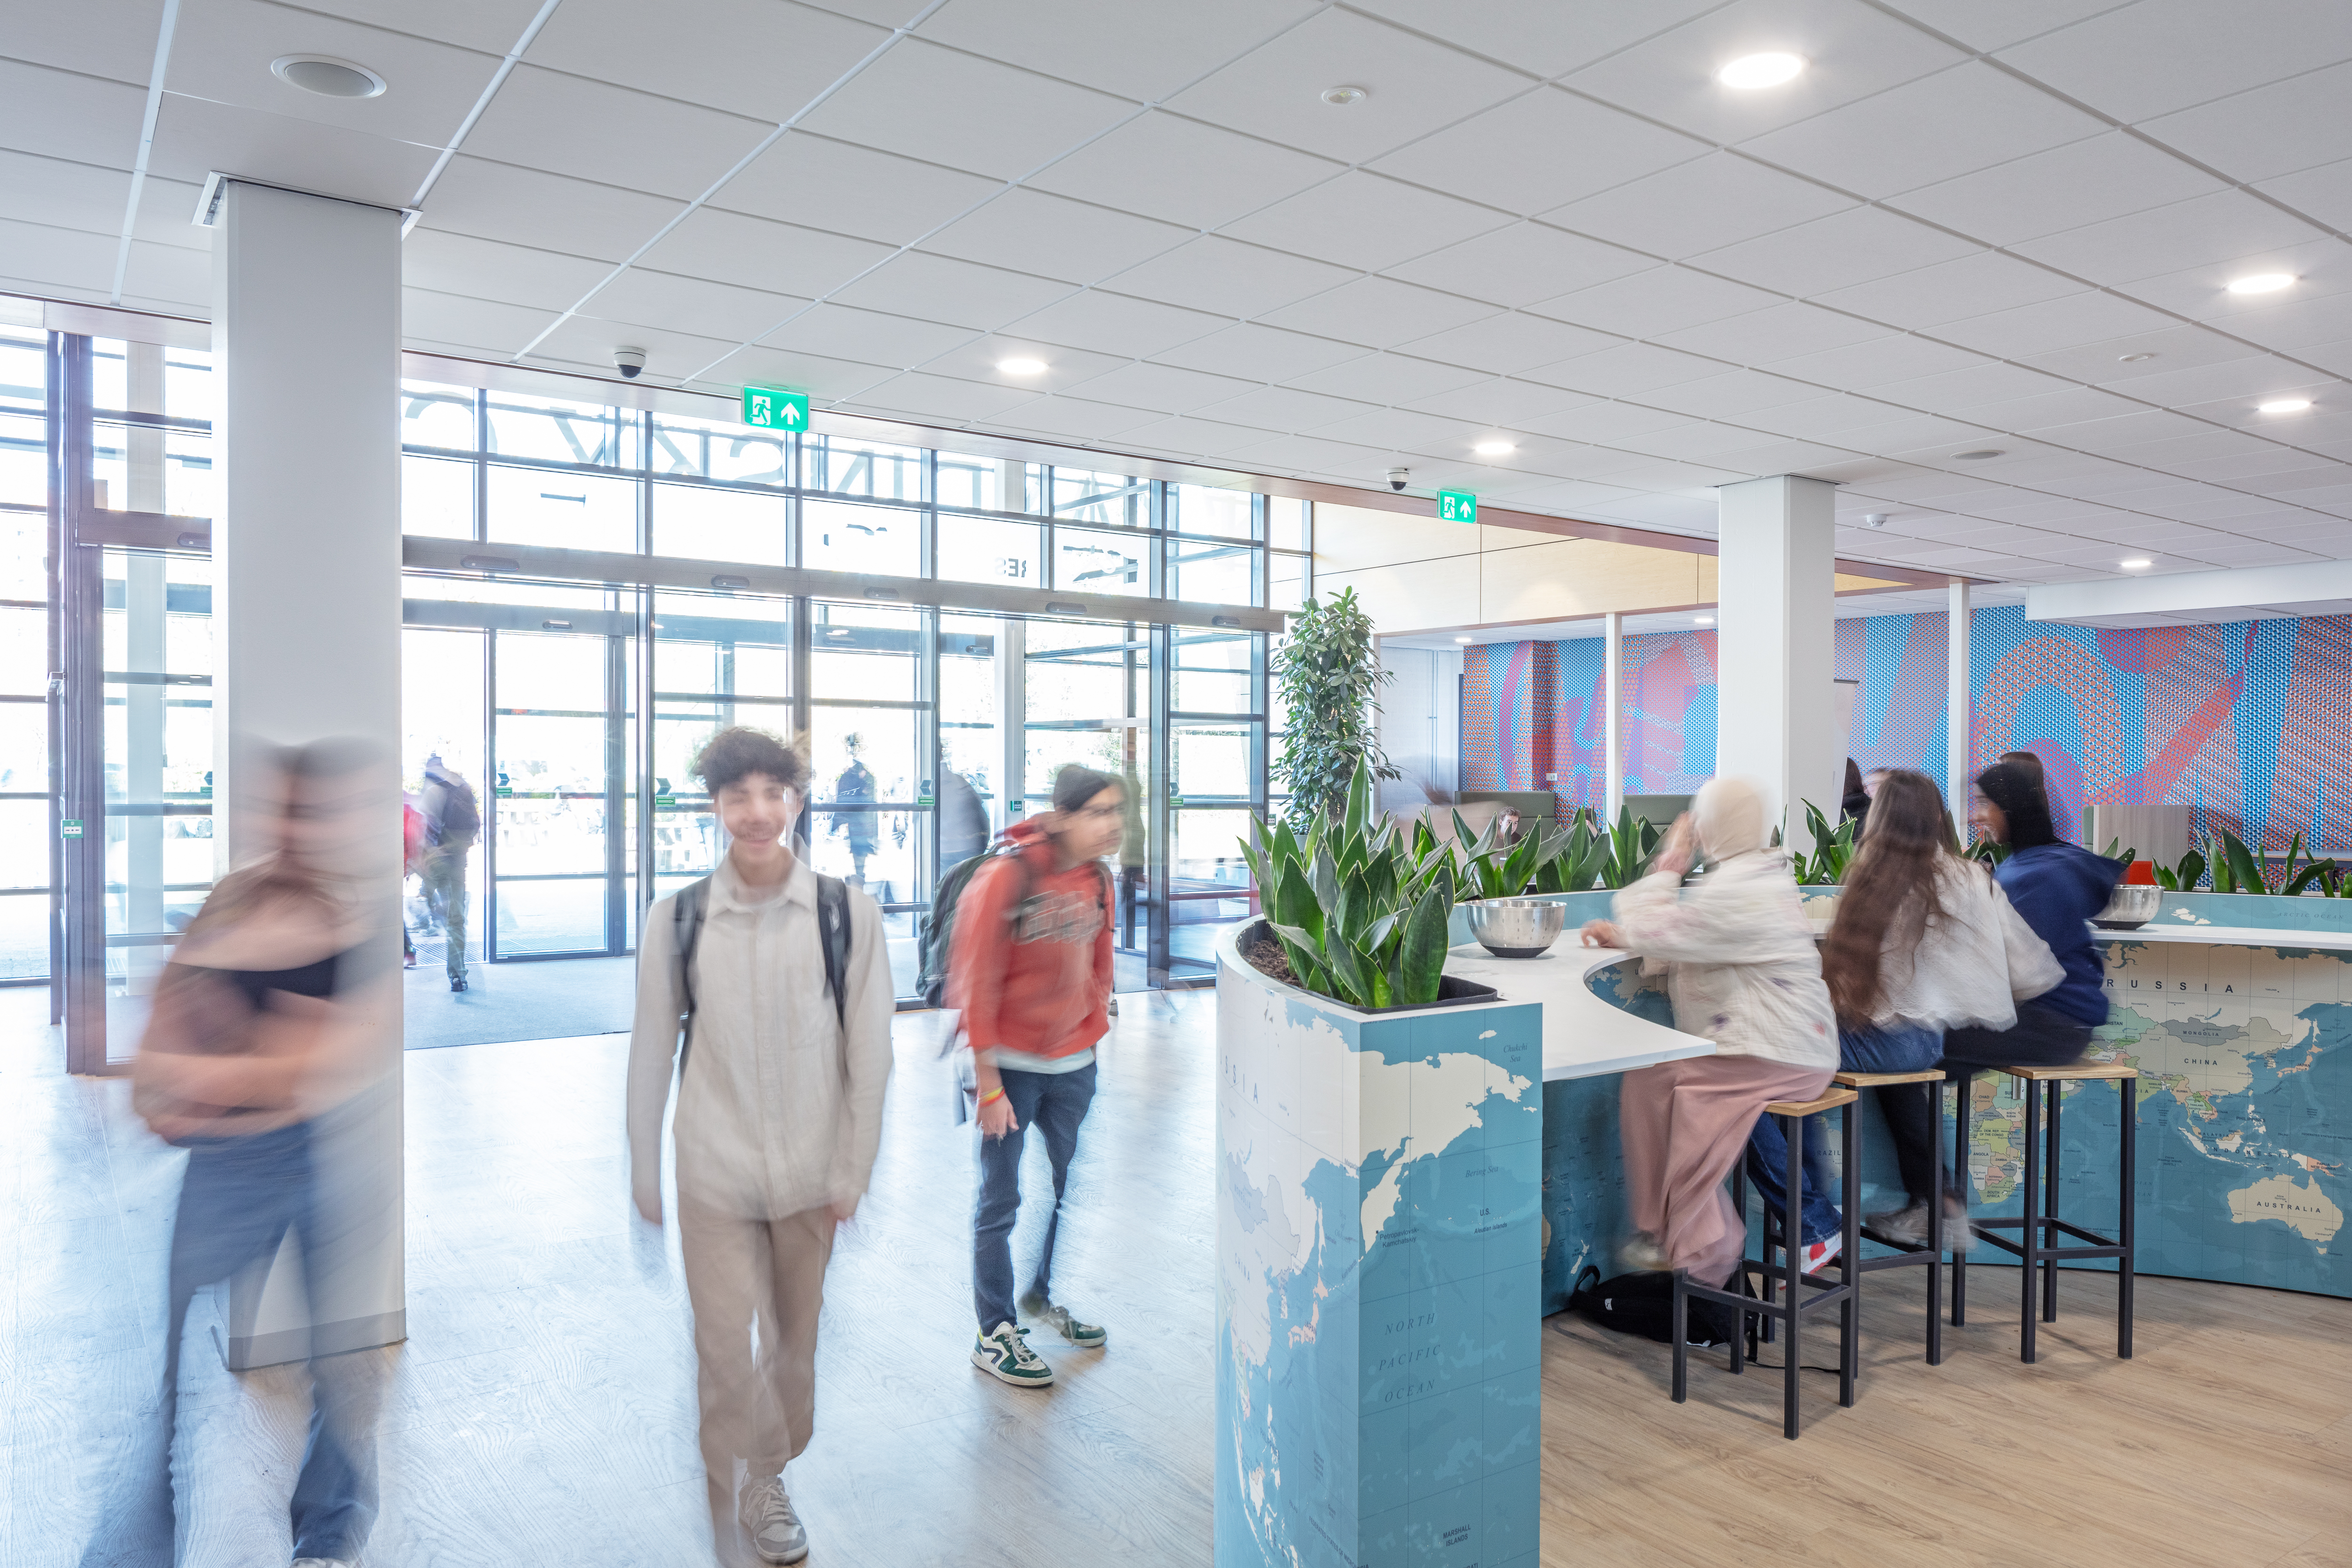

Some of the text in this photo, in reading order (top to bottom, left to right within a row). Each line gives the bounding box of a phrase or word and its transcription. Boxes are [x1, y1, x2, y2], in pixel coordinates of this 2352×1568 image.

[2106, 979, 2233, 993] RUSSIA
[1503, 1043, 1528, 1053] Chukchi
[2205, 1146, 2292, 1159] INDONESIA
[1466, 1168, 1486, 1178] Bering
[1479, 1208, 1491, 1217] U.S.
[2257, 1201, 2321, 1213] AUSTRALIA
[1380, 1227, 1420, 1241] Petropavlovsk-
[1474, 1226, 1493, 1234] Aleutian
[1383, 1235, 1417, 1248] Kamchatskiy
[1235, 1252, 1250, 1284] CHINA
[1304, 1320, 1317, 1337] JAPAN
[1385, 1313, 1435, 1335] NORTH
[1379, 1344, 1440, 1371] PACIFIC
[1385, 1379, 1435, 1402] OCEAN
[1309, 1516, 1327, 1539] FEDERATED
[1327, 1535, 1339, 1552] STATES
[1339, 1548, 1343, 1557] OF
[1443, 1524, 1471, 1539] MARSHALL
[1446, 1533, 1468, 1547] ISLANDS
